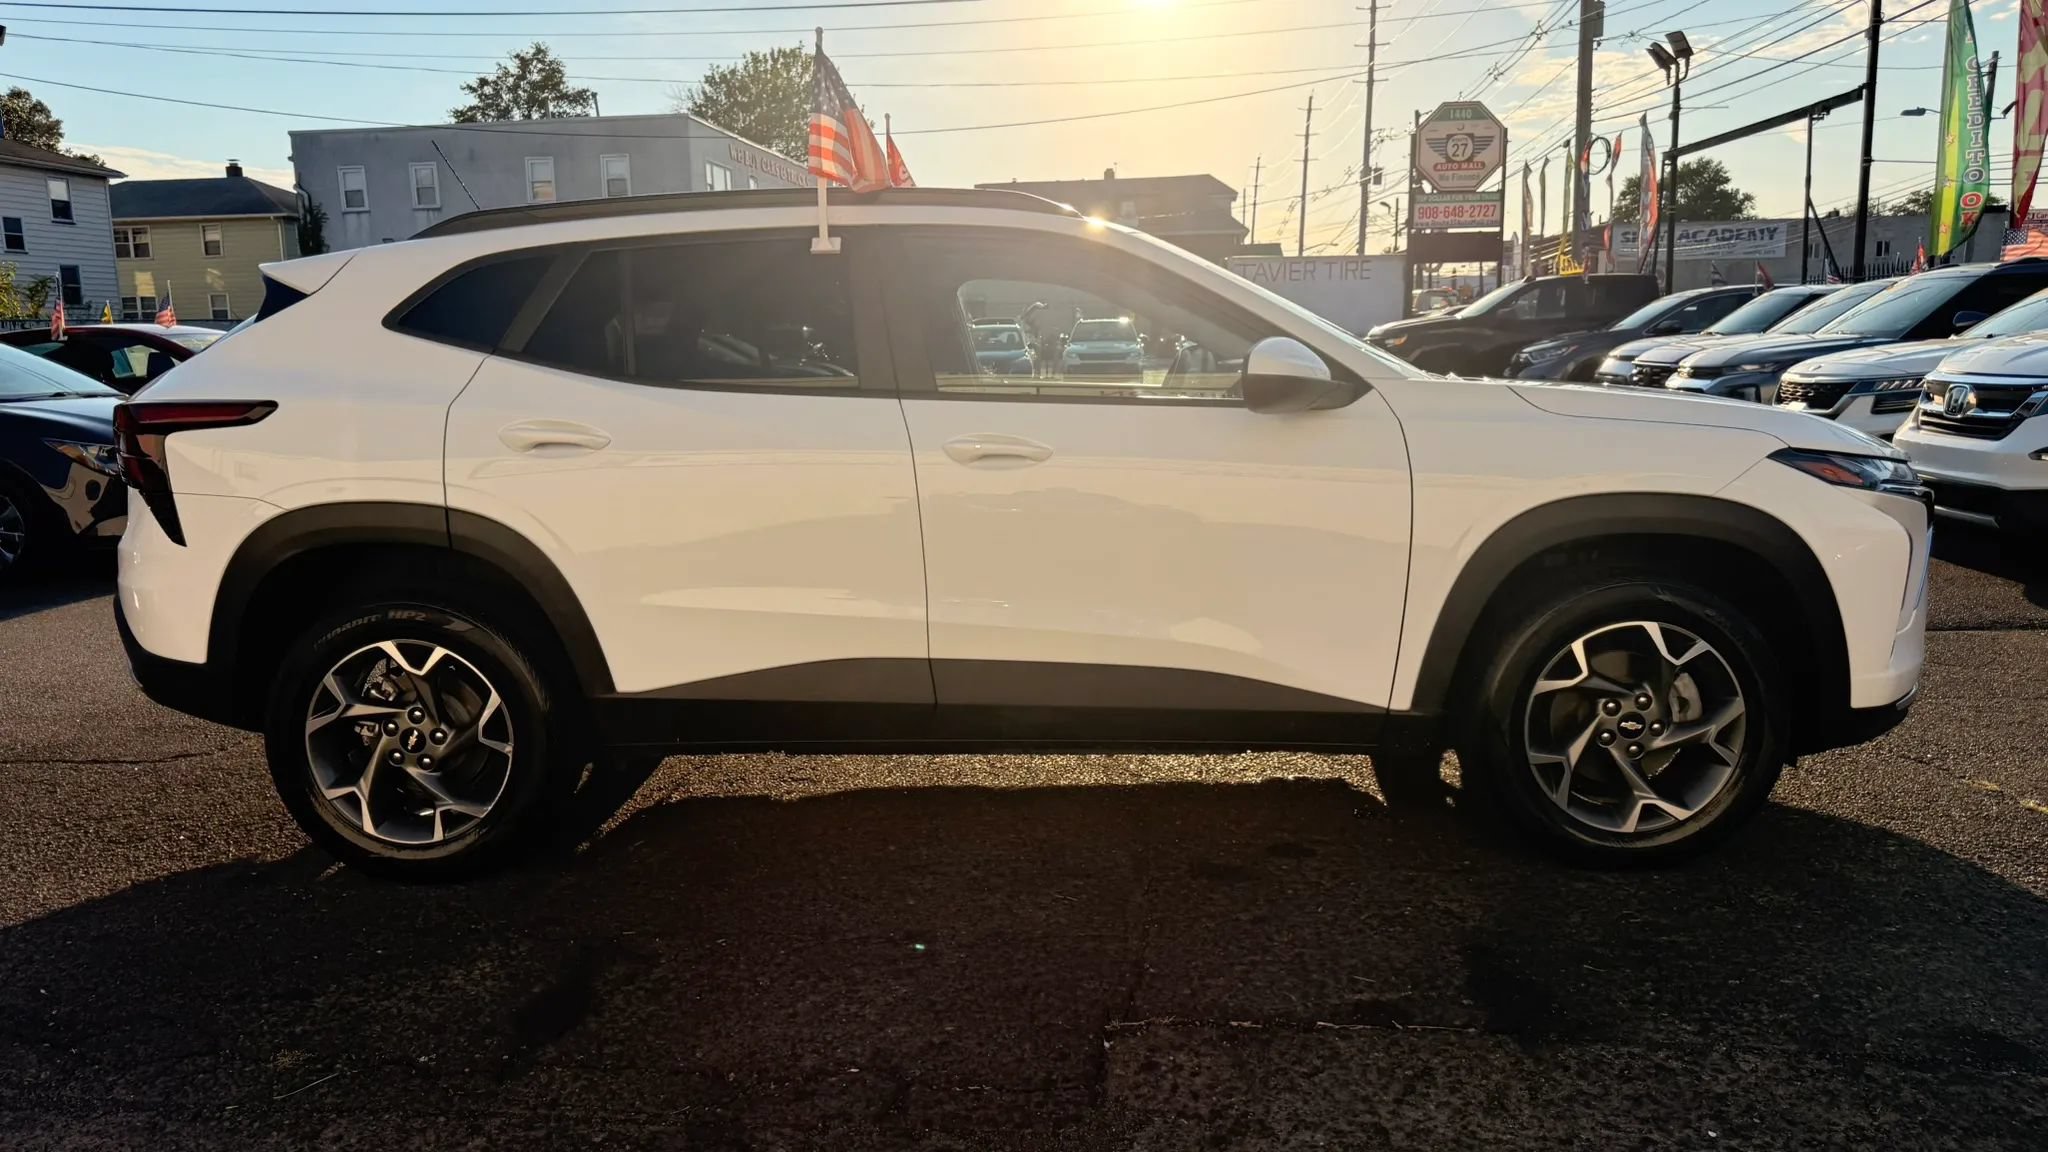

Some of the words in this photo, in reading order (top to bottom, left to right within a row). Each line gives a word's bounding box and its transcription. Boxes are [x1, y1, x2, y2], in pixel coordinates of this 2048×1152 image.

[1449, 108, 1472, 119] 1440
[1451, 143, 1468, 157] 27
[1418, 204, 1497, 219] 908-648-2727
[1960, 191, 1984, 227] OK
[1676, 226, 1779, 242] ACADEMY
[1233, 261, 1316, 282] TAVIER
[1325, 260, 1372, 280] TIRE
[387, 609, 426, 621] HP2
